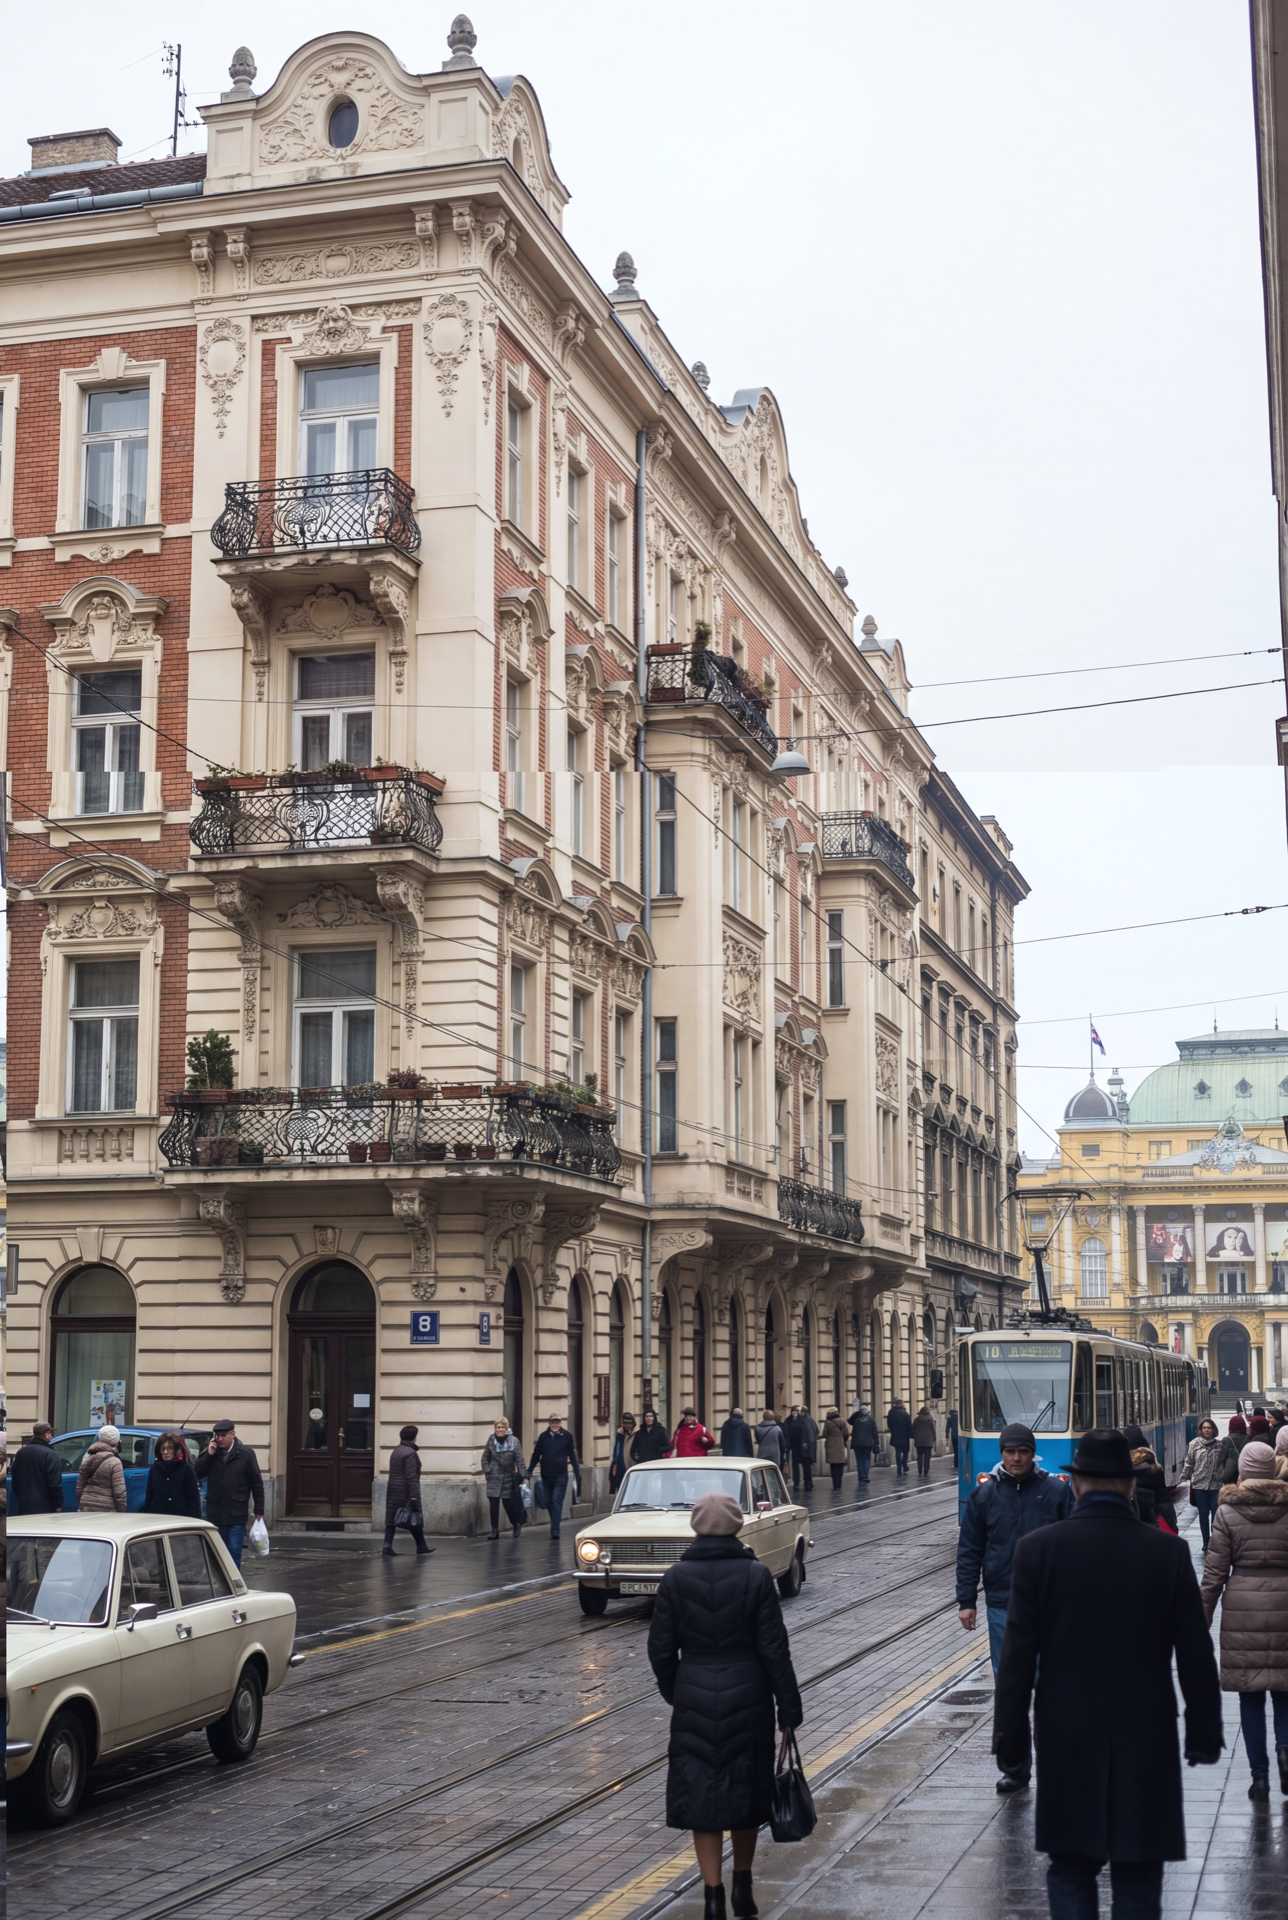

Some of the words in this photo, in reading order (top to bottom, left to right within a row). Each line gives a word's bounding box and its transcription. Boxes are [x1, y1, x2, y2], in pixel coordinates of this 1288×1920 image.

[419, 1315, 431, 1332] 8
[482, 1316, 488, 1333] 8
[985, 1346, 999, 1358] 10
